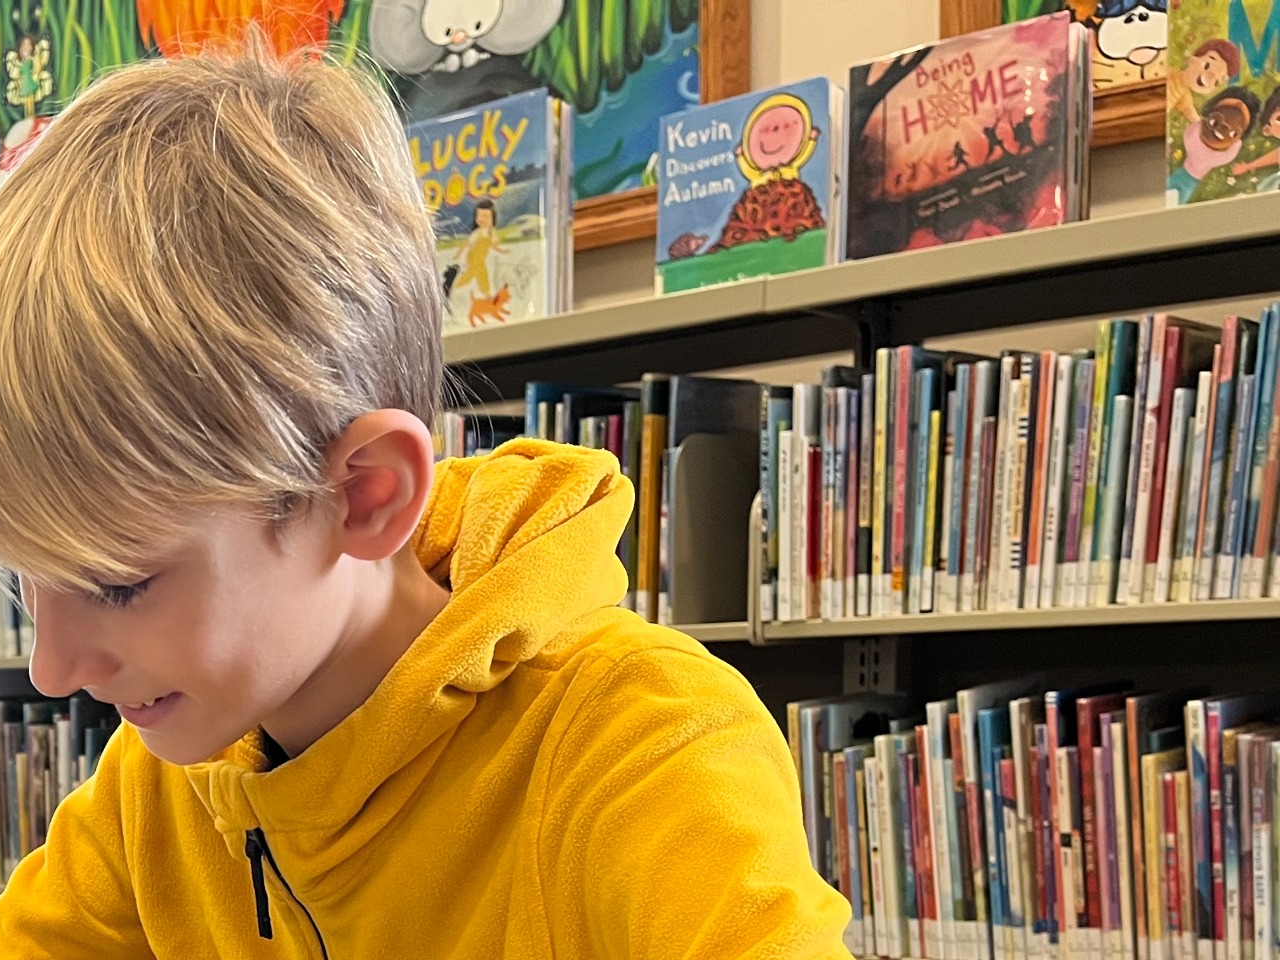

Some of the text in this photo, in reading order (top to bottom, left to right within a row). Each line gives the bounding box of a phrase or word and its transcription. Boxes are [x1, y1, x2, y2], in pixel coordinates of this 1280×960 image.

[409, 110, 529, 178] LUCKY
[666, 119, 734, 153] Kevin
[666, 151, 734, 178] Discovers
[423, 164, 508, 214] DOGS
[664, 177, 736, 206] Autumn
